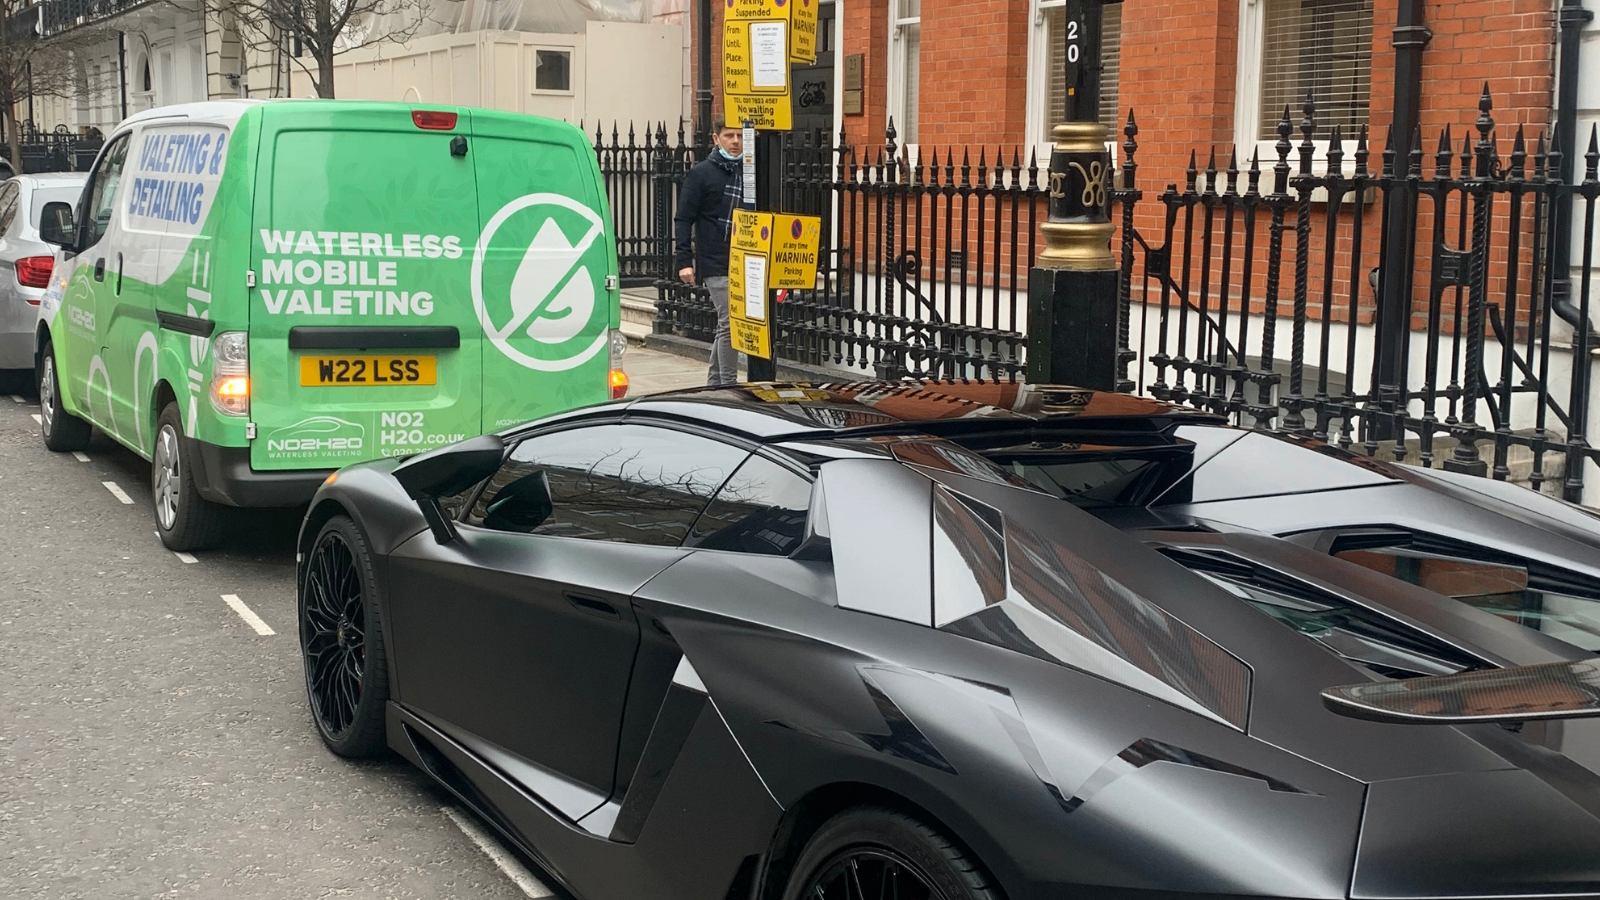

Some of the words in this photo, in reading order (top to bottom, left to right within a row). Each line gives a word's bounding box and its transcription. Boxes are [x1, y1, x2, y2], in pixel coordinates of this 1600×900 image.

[736, 8, 771, 17] Suspended
[794, 18, 815, 35] WARNING
[737, 105, 747, 113] No
[748, 105, 774, 116] waiting
[139, 133, 211, 175] VALETING
[209, 133, 225, 175] &
[129, 178, 204, 225] DETAILING
[260, 229, 463, 259] WATERLESS
[775, 252, 814, 264] WARNING
[262, 259, 397, 286] MOBILE
[784, 267, 802, 277] Parking
[779, 277, 805, 286] suspension
[260, 290, 434, 316] VALETING
[319, 360, 366, 382] W22
[373, 360, 420, 382] LSS
[381, 412, 424, 427] NO2
